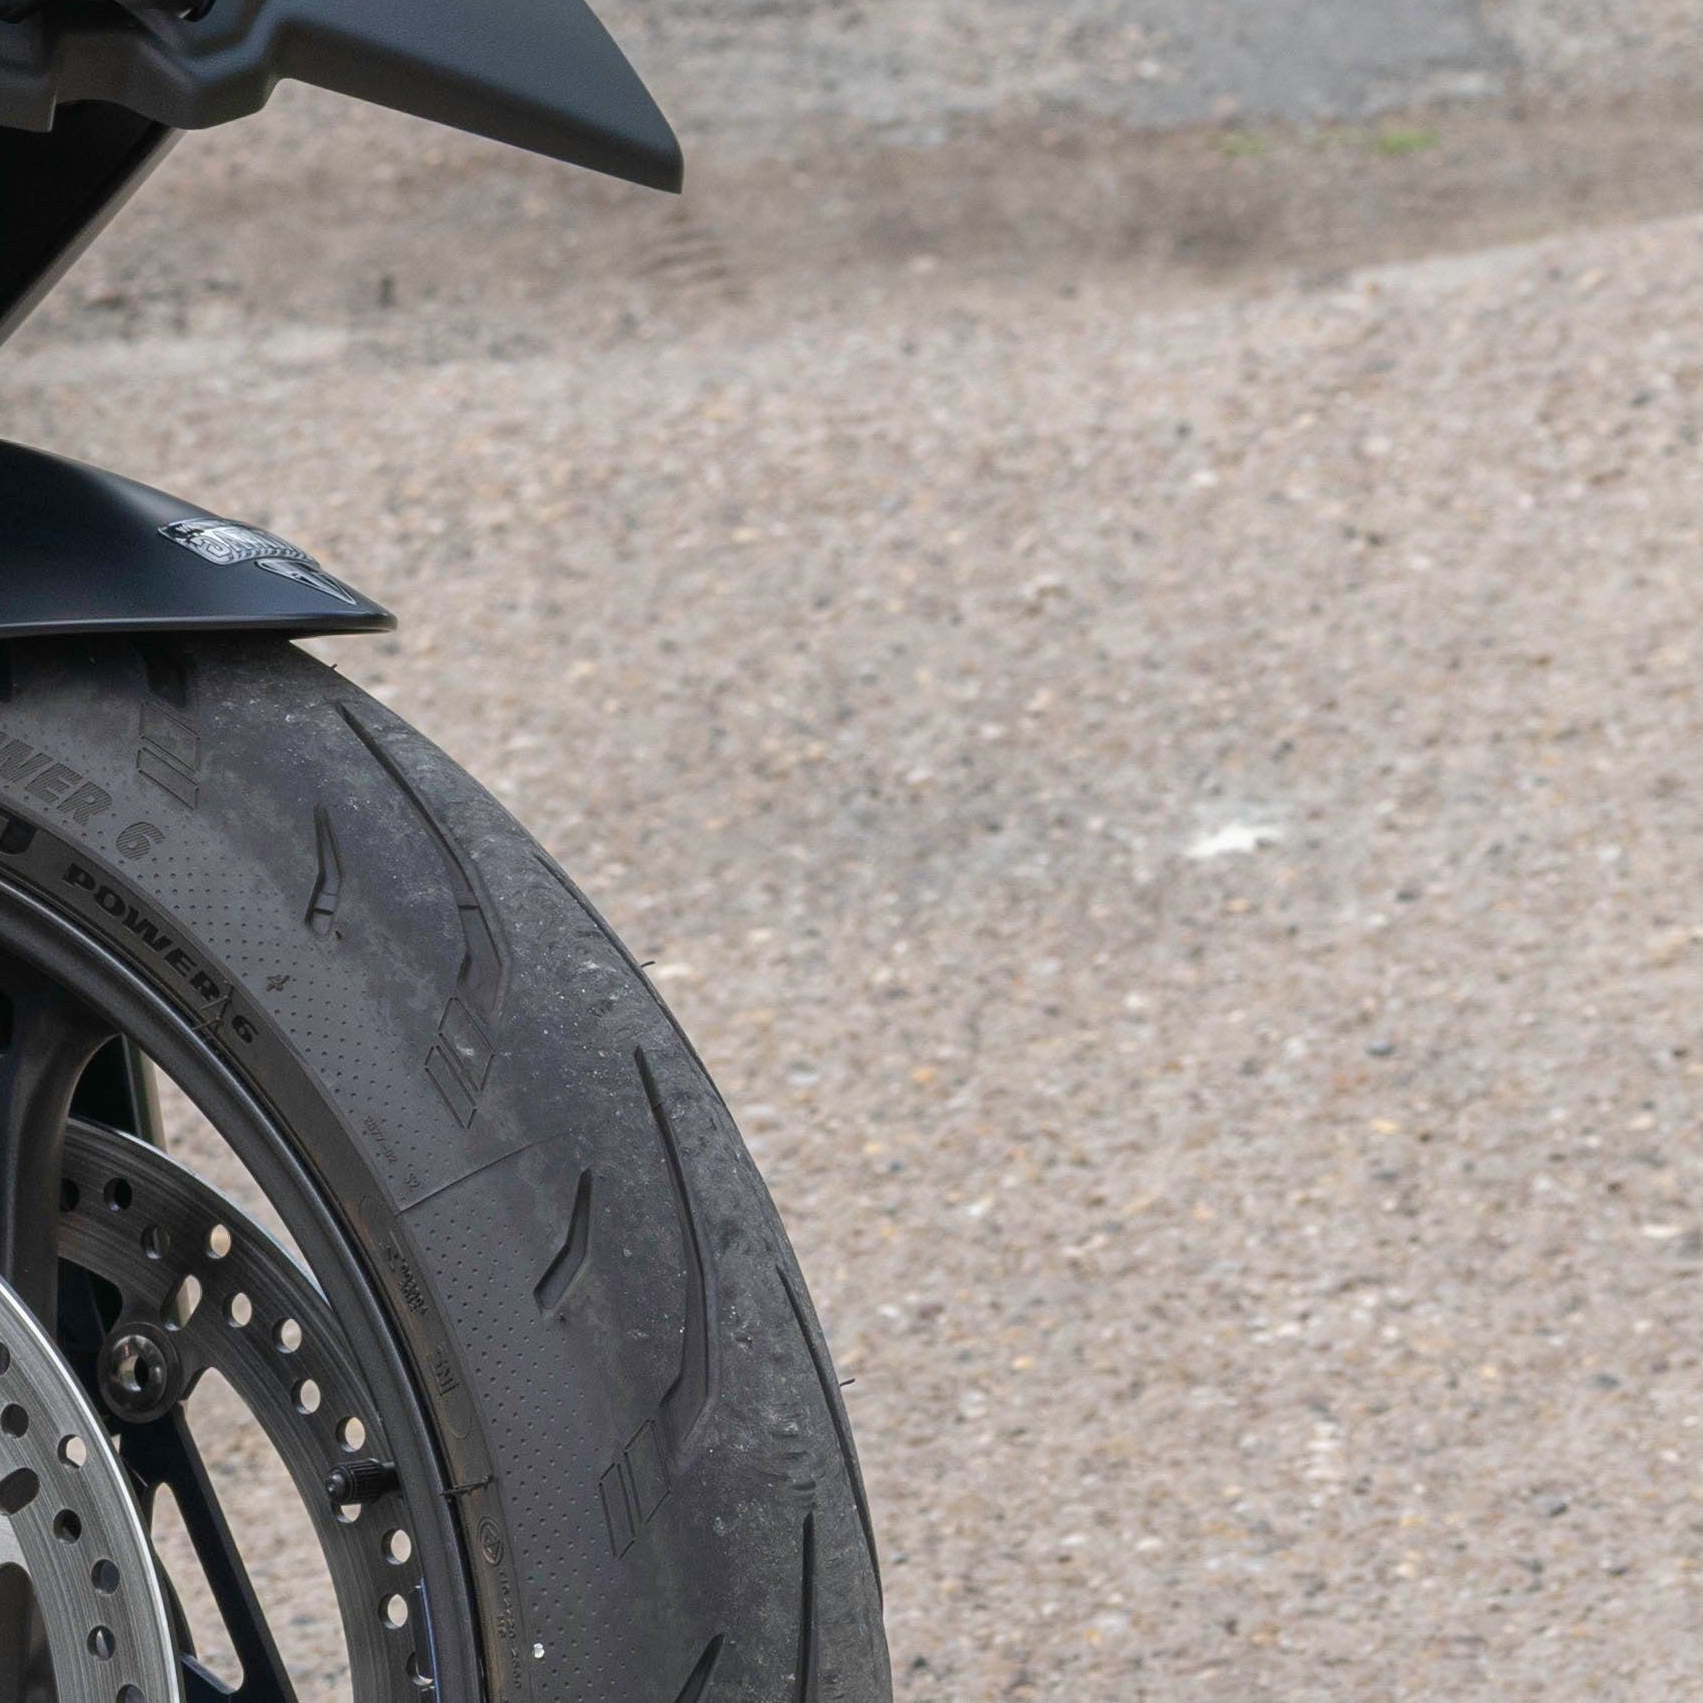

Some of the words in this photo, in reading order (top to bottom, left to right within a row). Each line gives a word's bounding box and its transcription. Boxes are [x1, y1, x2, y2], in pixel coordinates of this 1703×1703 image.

[115, 821, 166, 861] 6
[62, 863, 221, 1002] POWER
[231, 1014, 261, 1044] 6
